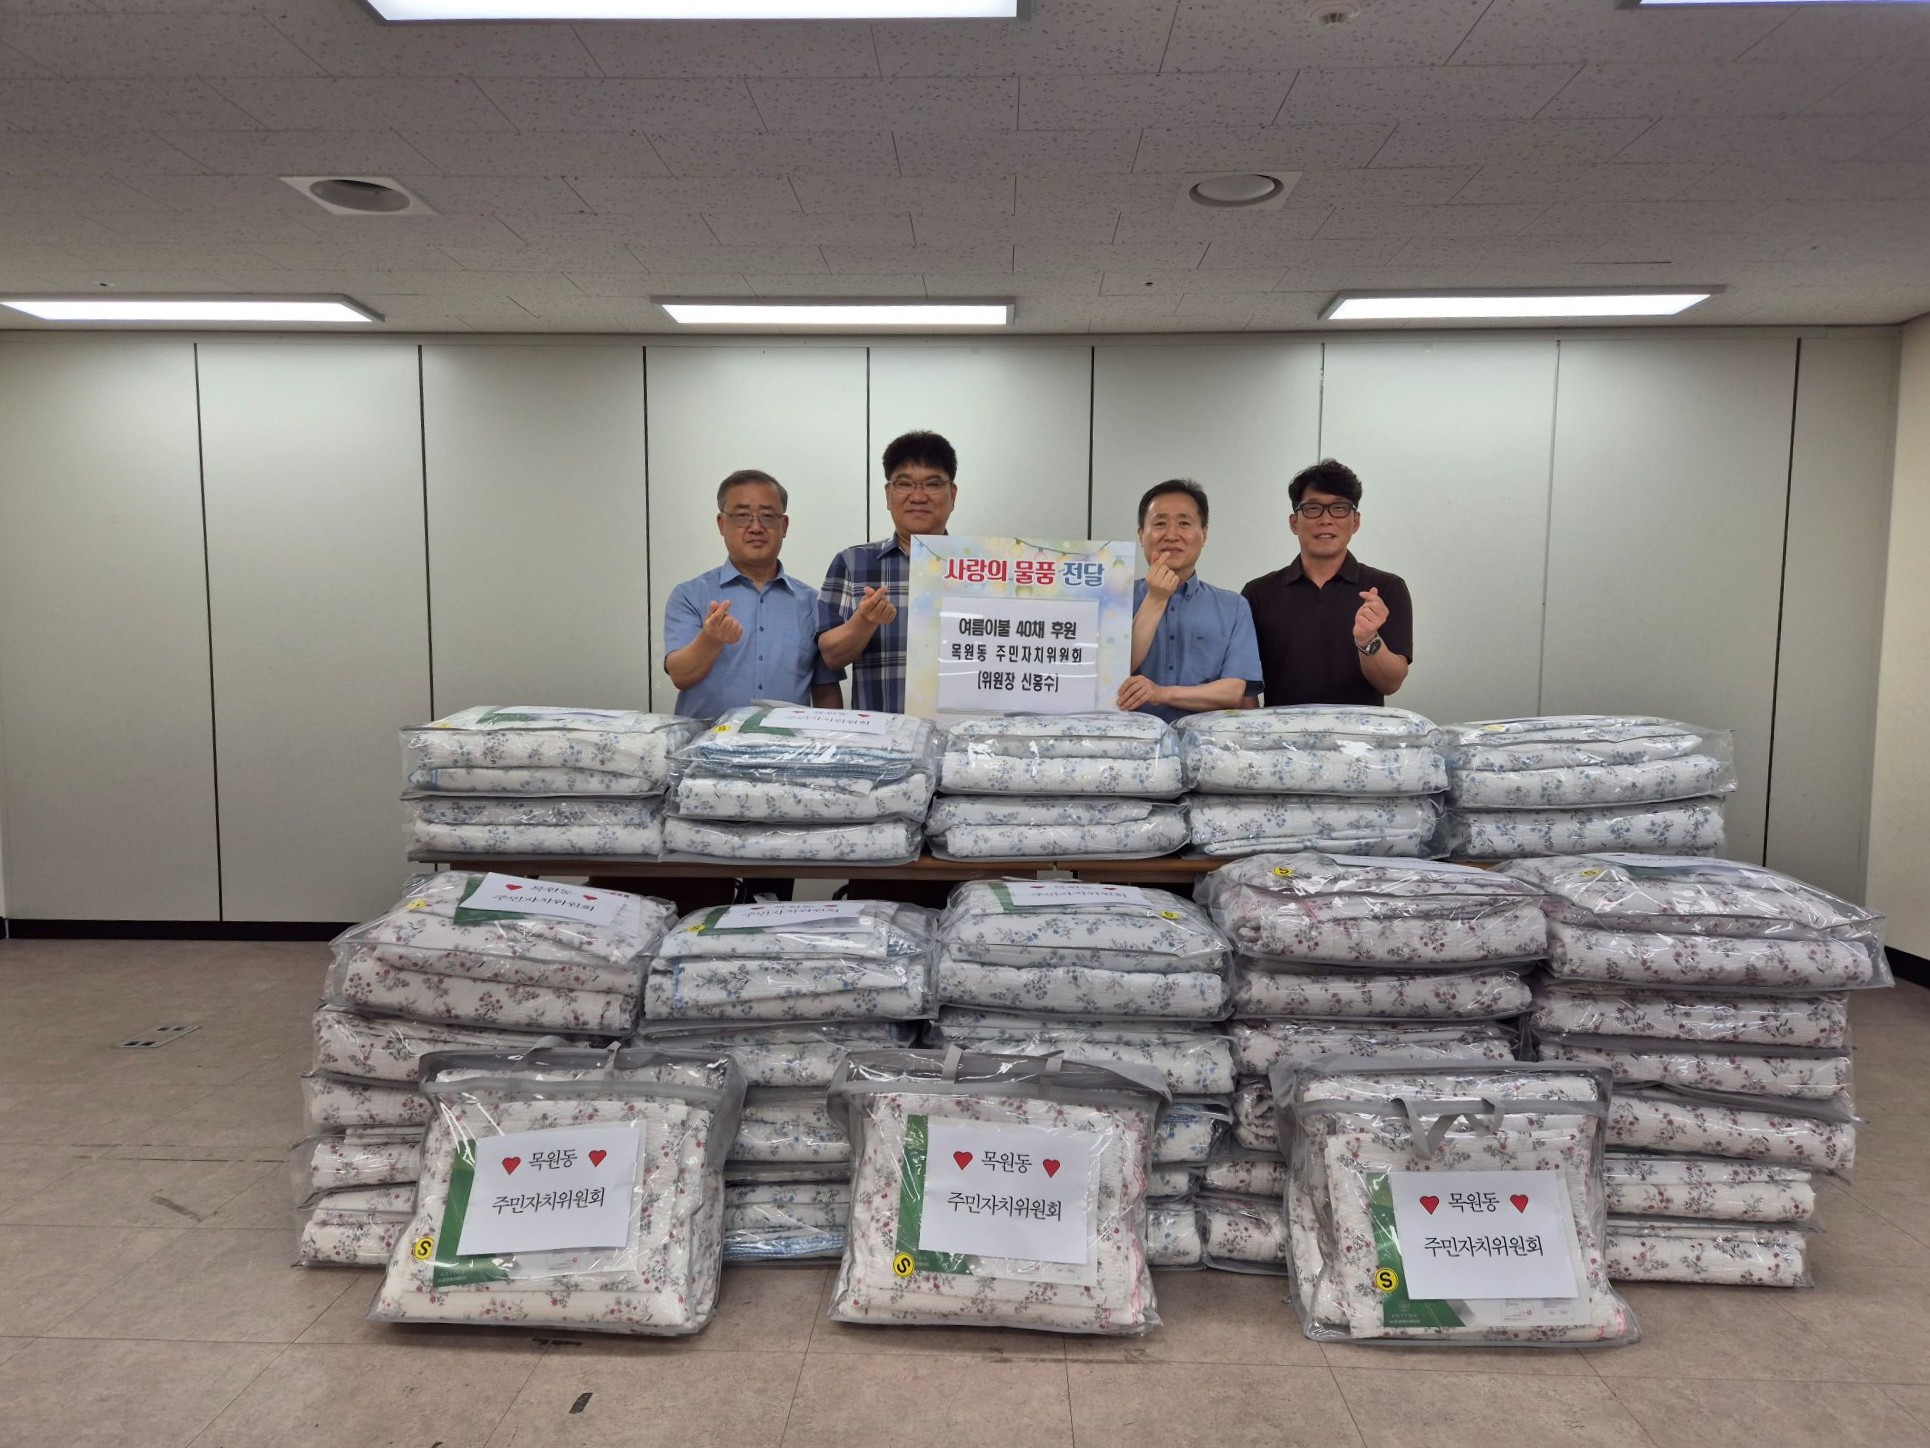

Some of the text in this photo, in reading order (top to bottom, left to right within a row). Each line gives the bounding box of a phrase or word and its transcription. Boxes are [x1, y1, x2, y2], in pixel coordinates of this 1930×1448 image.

[945, 558, 1104, 587] 사랑의 물품 전달
[959, 618, 1077, 640] 여름이불 40채 후원
[951, 644, 1082, 664] 목원동 주민자치위원회
[977, 670, 1059, 693] (위원장 신홍수)
[528, 1148, 578, 1171] 목원동
[981, 1150, 1033, 1174] 목원동
[492, 1187, 605, 1216] 주민자치위원회
[947, 1191, 1062, 1222] 주민자치위원회
[1448, 1191, 1500, 1213] 목원동
[417, 1239, 432, 1256] S
[1424, 1235, 1543, 1258] 주민자치위원회
[896, 1257, 911, 1274] S
[1379, 1272, 1393, 1289] S
